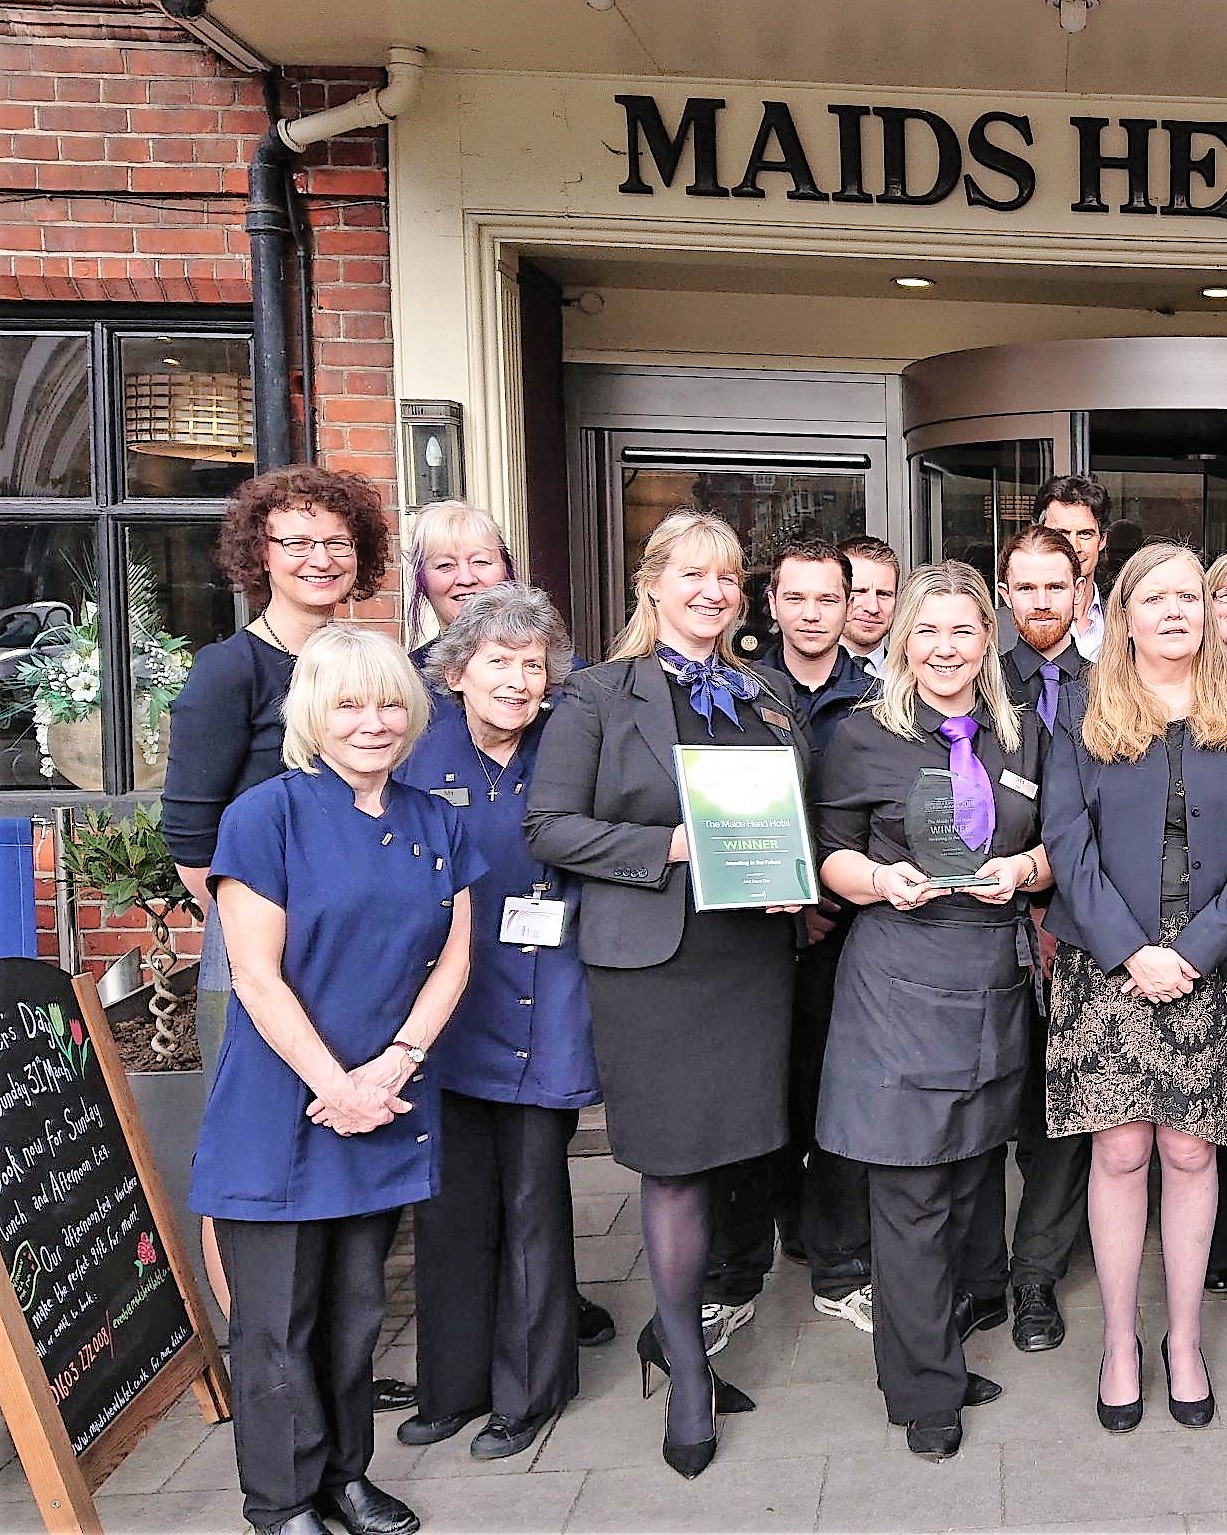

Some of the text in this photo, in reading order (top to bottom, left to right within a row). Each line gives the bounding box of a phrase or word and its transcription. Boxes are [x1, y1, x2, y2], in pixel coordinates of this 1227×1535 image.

[614, 95, 1036, 213] MAIDS
[723, 840, 780, 850] WINNER
[930, 825, 972, 835] WINNER
[17, 1002, 55, 1049] Day
[42, 1052, 72, 1094] March
[0, 1097, 103, 1193] ook now for Sunday
[32, 1183, 49, 1211] and
[49, 1160, 92, 1202] Afternoon
[40, 1245, 62, 1272] Our
[53, 1282, 68, 1304] the
[67, 1254, 90, 1291] perfect
[90, 1237, 108, 1266] gift
[107, 1226, 119, 1251] for
